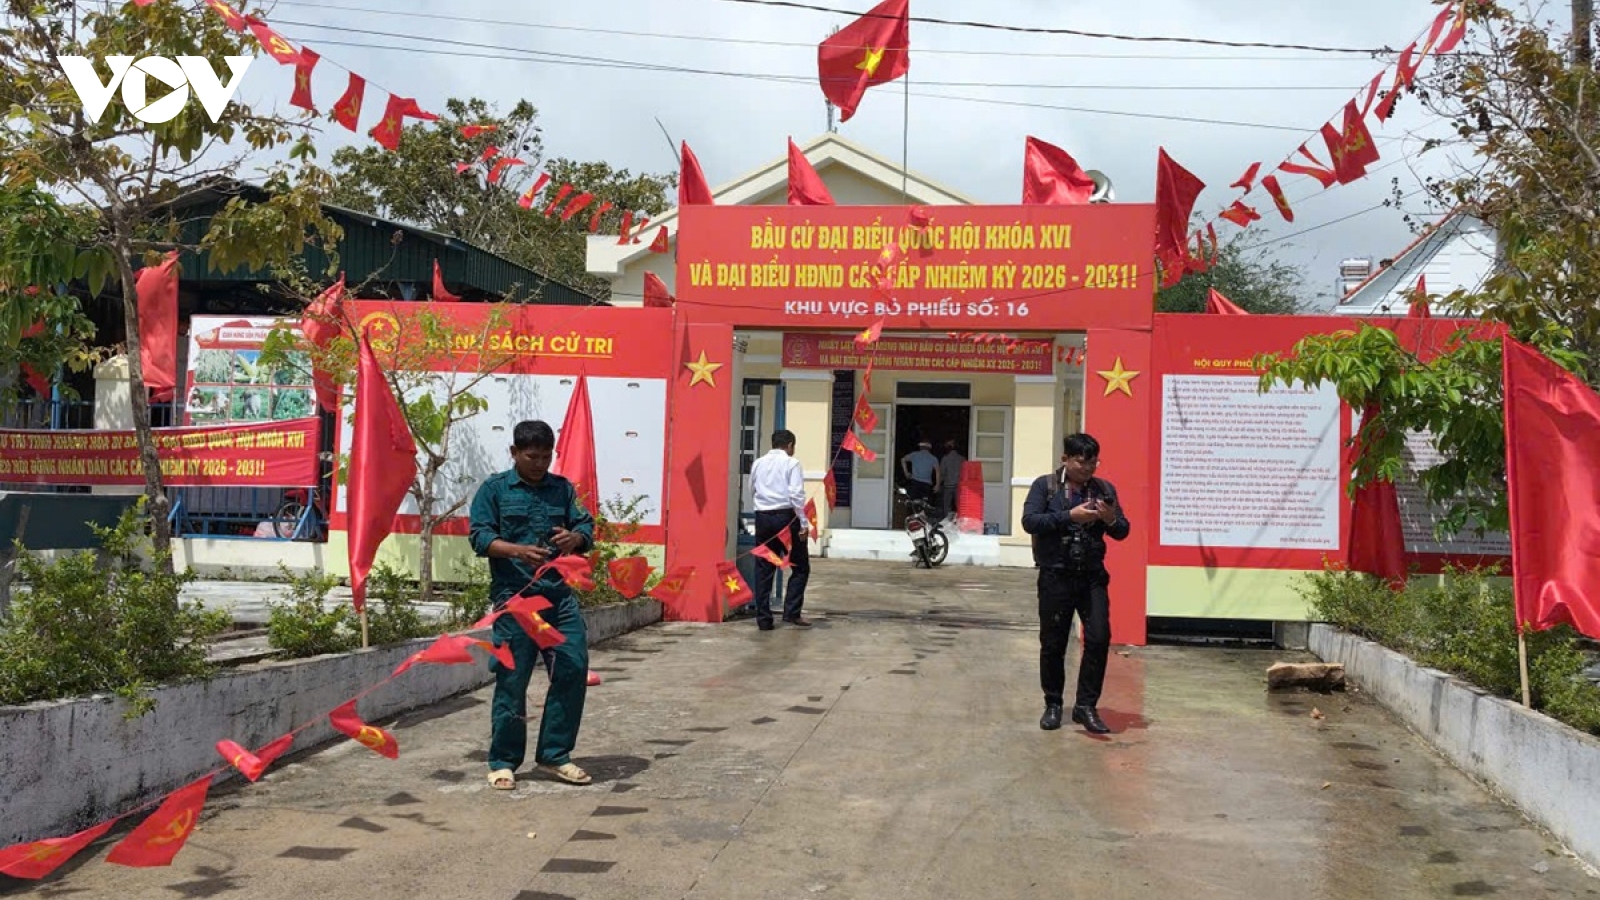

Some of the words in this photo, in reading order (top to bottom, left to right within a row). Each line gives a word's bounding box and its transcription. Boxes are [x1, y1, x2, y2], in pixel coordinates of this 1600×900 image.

[751, 216, 787, 249] BẦU
[791, 219, 815, 249] CỬ
[818, 226, 848, 253] ĐẠI
[852, 216, 894, 249] BIỂU
[898, 217, 945, 254] QUỐC
[949, 221, 980, 254] HỘI
[985, 220, 1035, 249] KHÓA
[1040, 225, 1071, 249] XVI
[689, 259, 713, 287] VÀ
[717, 263, 746, 290] ĐẠI
[750, 254, 790, 287] BIỂU
[794, 265, 844, 287] HĐND
[925, 260, 987, 293] NHIỆM
[992, 260, 1016, 288] KỲ
[1022, 265, 1066, 288] 2026
[1085, 265, 1137, 288] 2031!
[785, 301, 823, 315] KHU
[828, 300, 869, 318] VỰC
[874, 298, 902, 316] BỎ
[907, 297, 961, 316] PHIẾU
[967, 297, 999, 316] SỐ:
[1007, 302, 1029, 316] 16
[490, 330, 543, 351] SÁCH
[550, 330, 580, 352] CỬ
[584, 337, 613, 354] TRI
[1194, 358, 1210, 369] NỘI
[1212, 359, 1232, 368] QUY
[58, 456, 85, 475] NHÂN
[87, 456, 109, 475] DÂN
[110, 456, 128, 475] CÁC
[130, 454, 145, 475] CẤ
[159, 456, 184, 478] HIỆM
[187, 456, 200, 475] KỲ
[203, 459, 227, 476] 2026
[236, 459, 265, 476] 2031!
